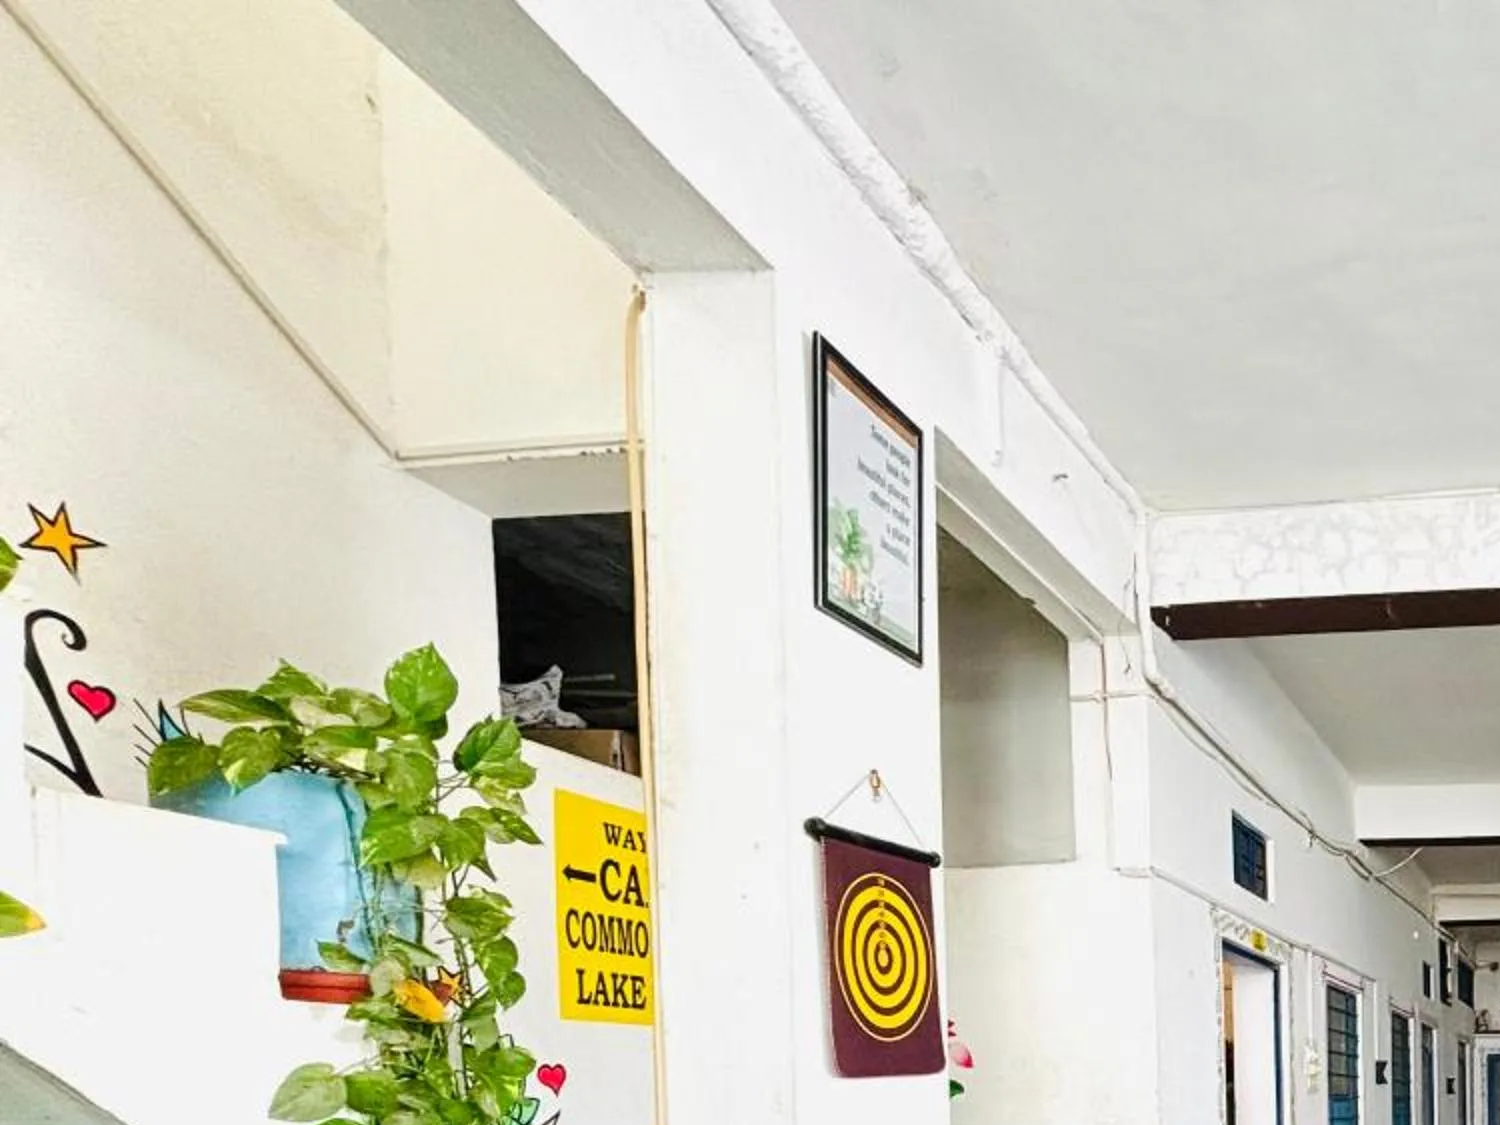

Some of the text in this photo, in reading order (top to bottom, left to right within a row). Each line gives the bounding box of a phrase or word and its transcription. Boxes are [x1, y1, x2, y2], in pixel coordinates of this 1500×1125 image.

[603, 822, 647, 853] WAY
[599, 858, 650, 908] CA
[576, 969, 647, 1010] LAKE
